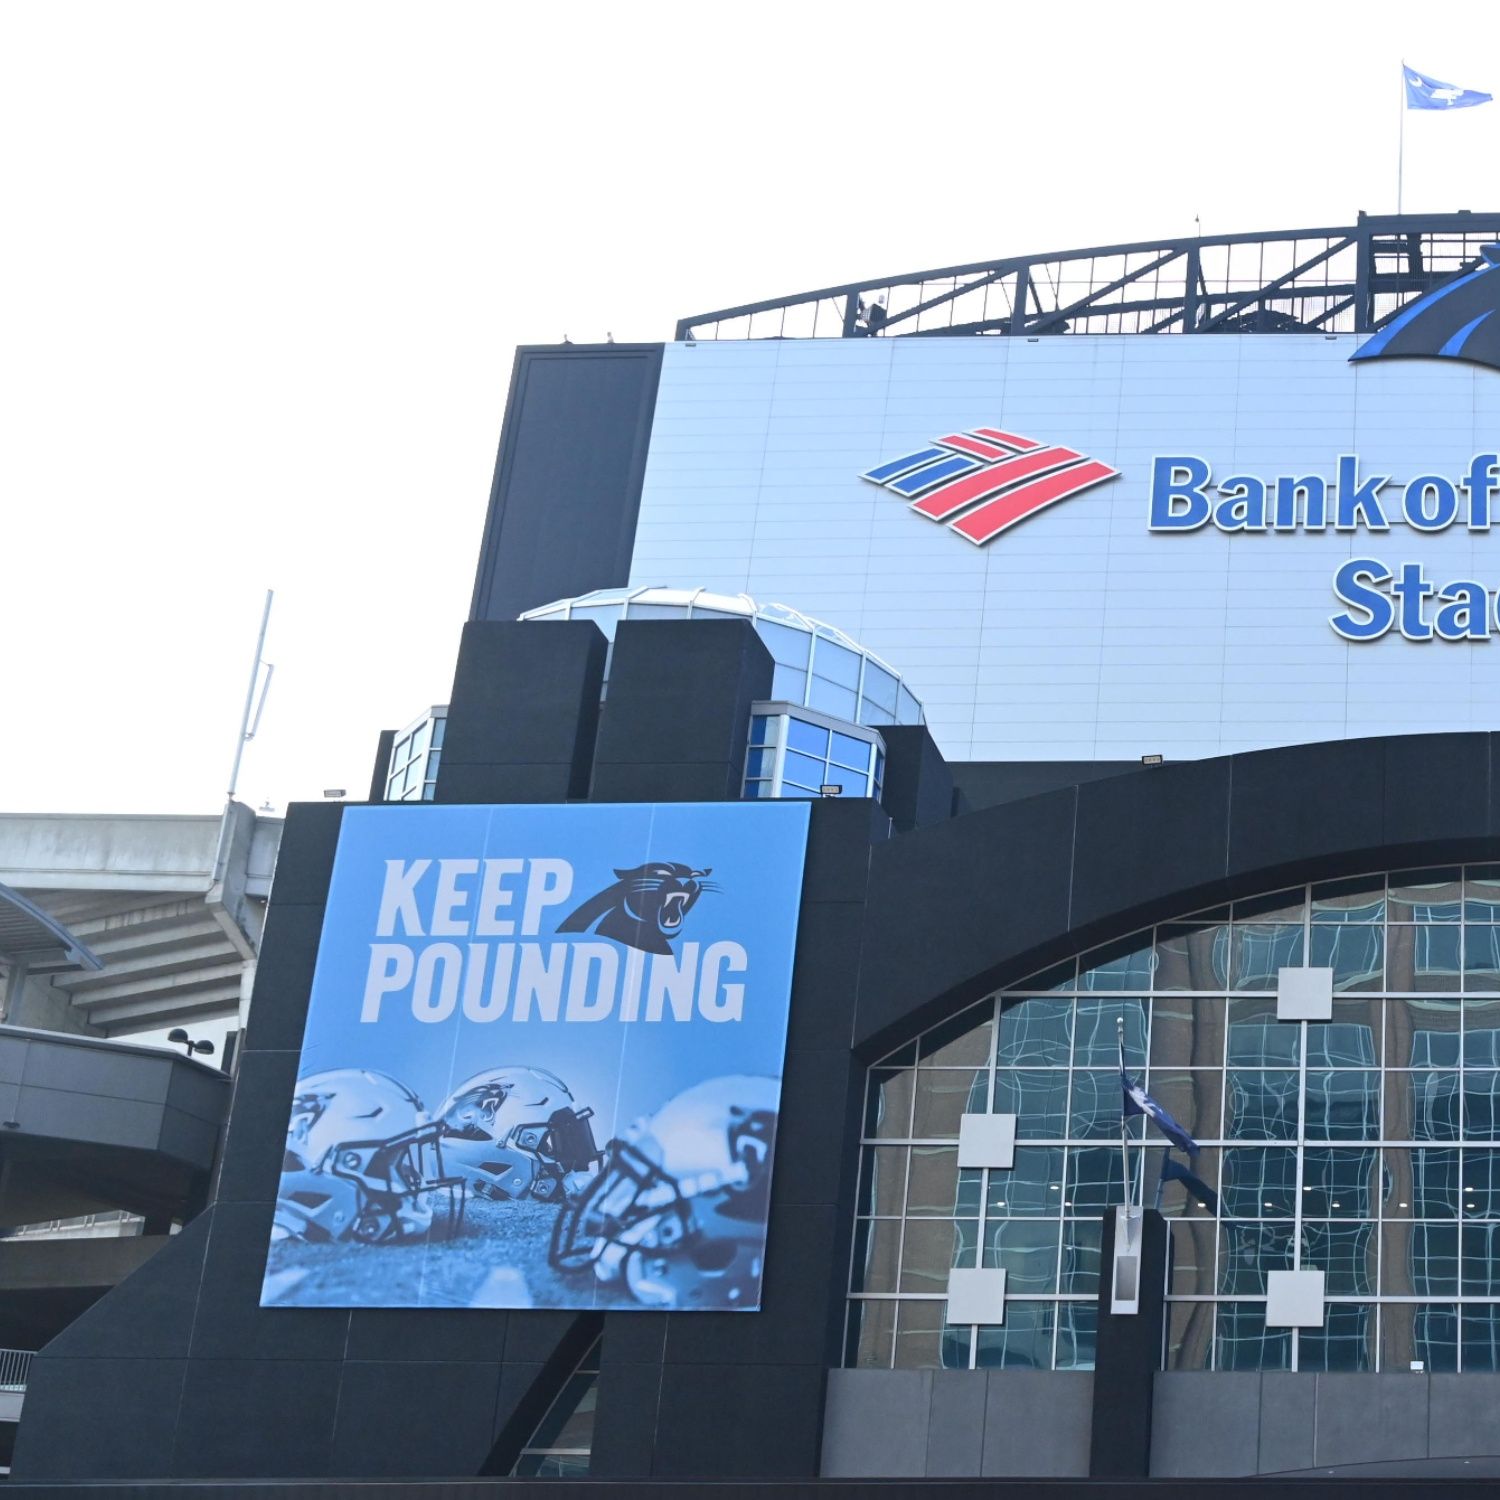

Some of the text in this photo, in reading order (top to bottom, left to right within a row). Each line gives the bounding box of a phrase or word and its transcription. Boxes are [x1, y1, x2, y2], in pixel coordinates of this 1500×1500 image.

[1148, 453, 1393, 532] Bank
[375, 858, 574, 937] KEEP
[360, 941, 747, 1023] POUNDING
